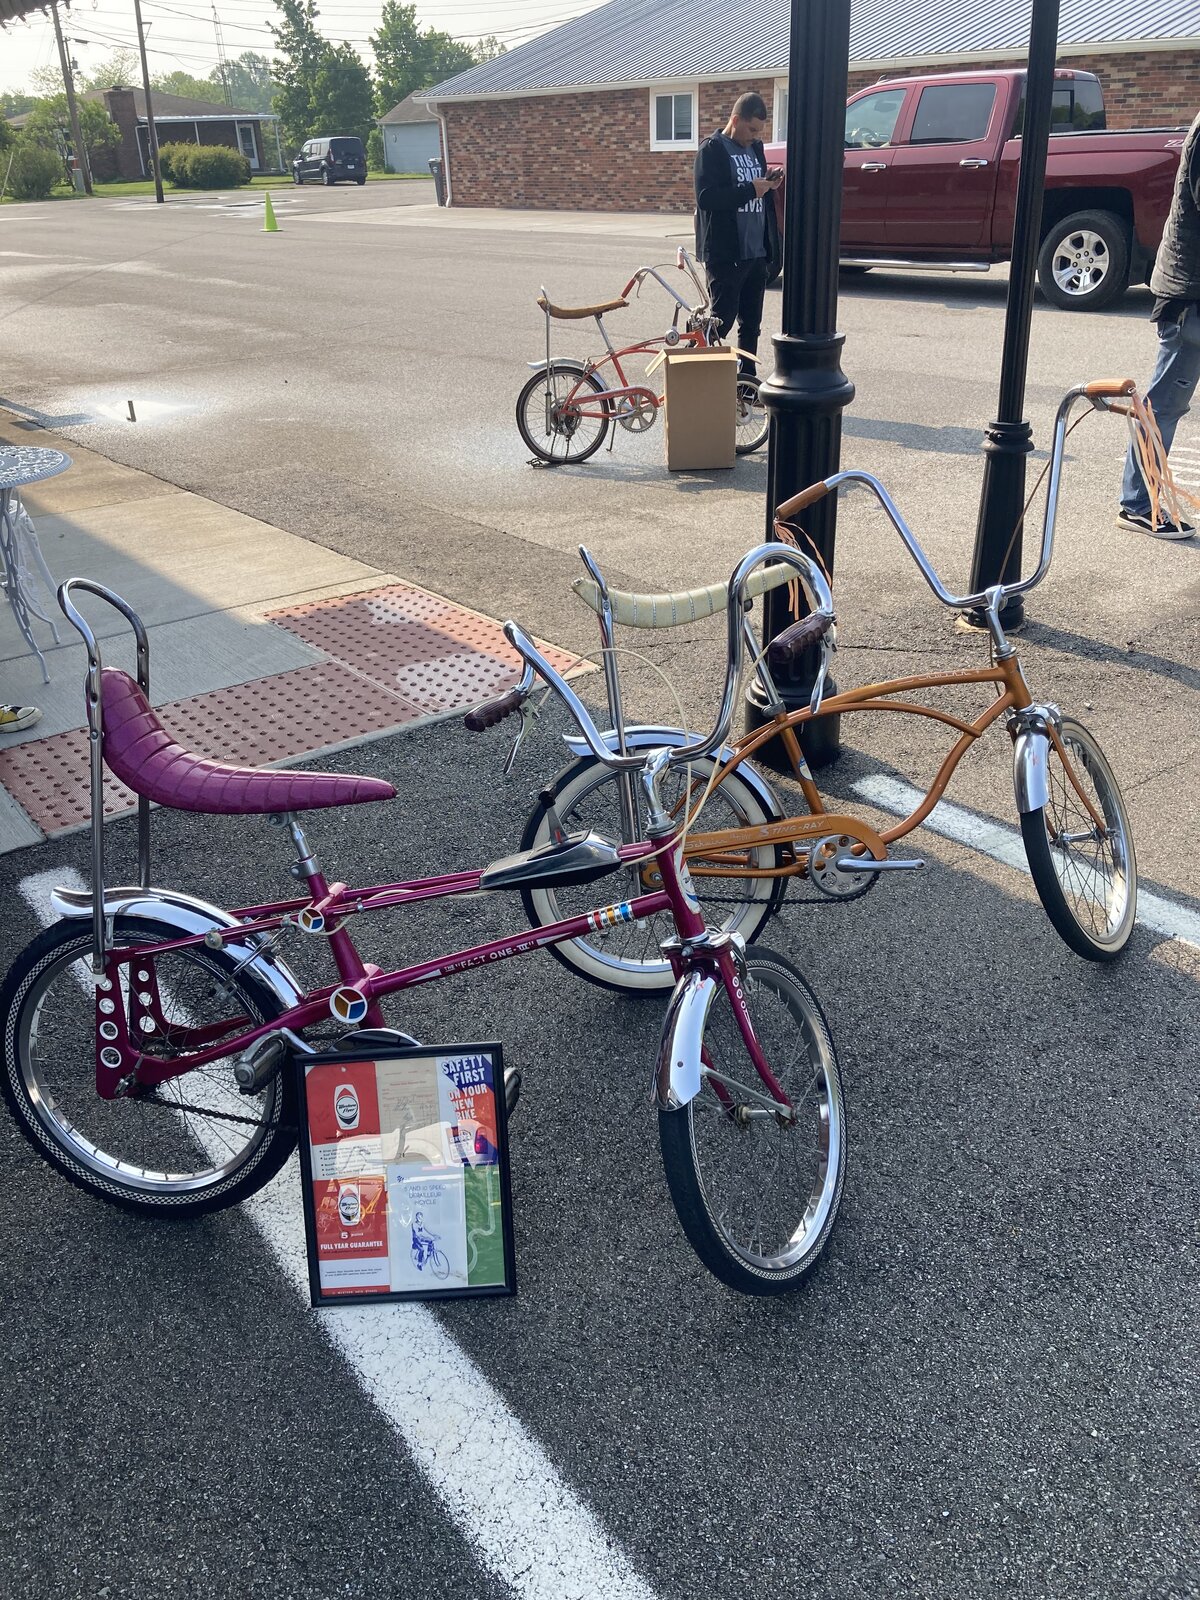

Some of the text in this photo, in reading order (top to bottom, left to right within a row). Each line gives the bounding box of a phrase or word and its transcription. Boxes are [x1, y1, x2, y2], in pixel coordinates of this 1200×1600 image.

[442, 1055, 483, 1074] SAFETY
[453, 1068, 485, 1085] FIRST
[448, 1084, 487, 1100] ON YOUR
[452, 1097, 475, 1111] NEW
[456, 1109, 477, 1120] BIKE
[350, 1240, 383, 1249] GUARANTEE
